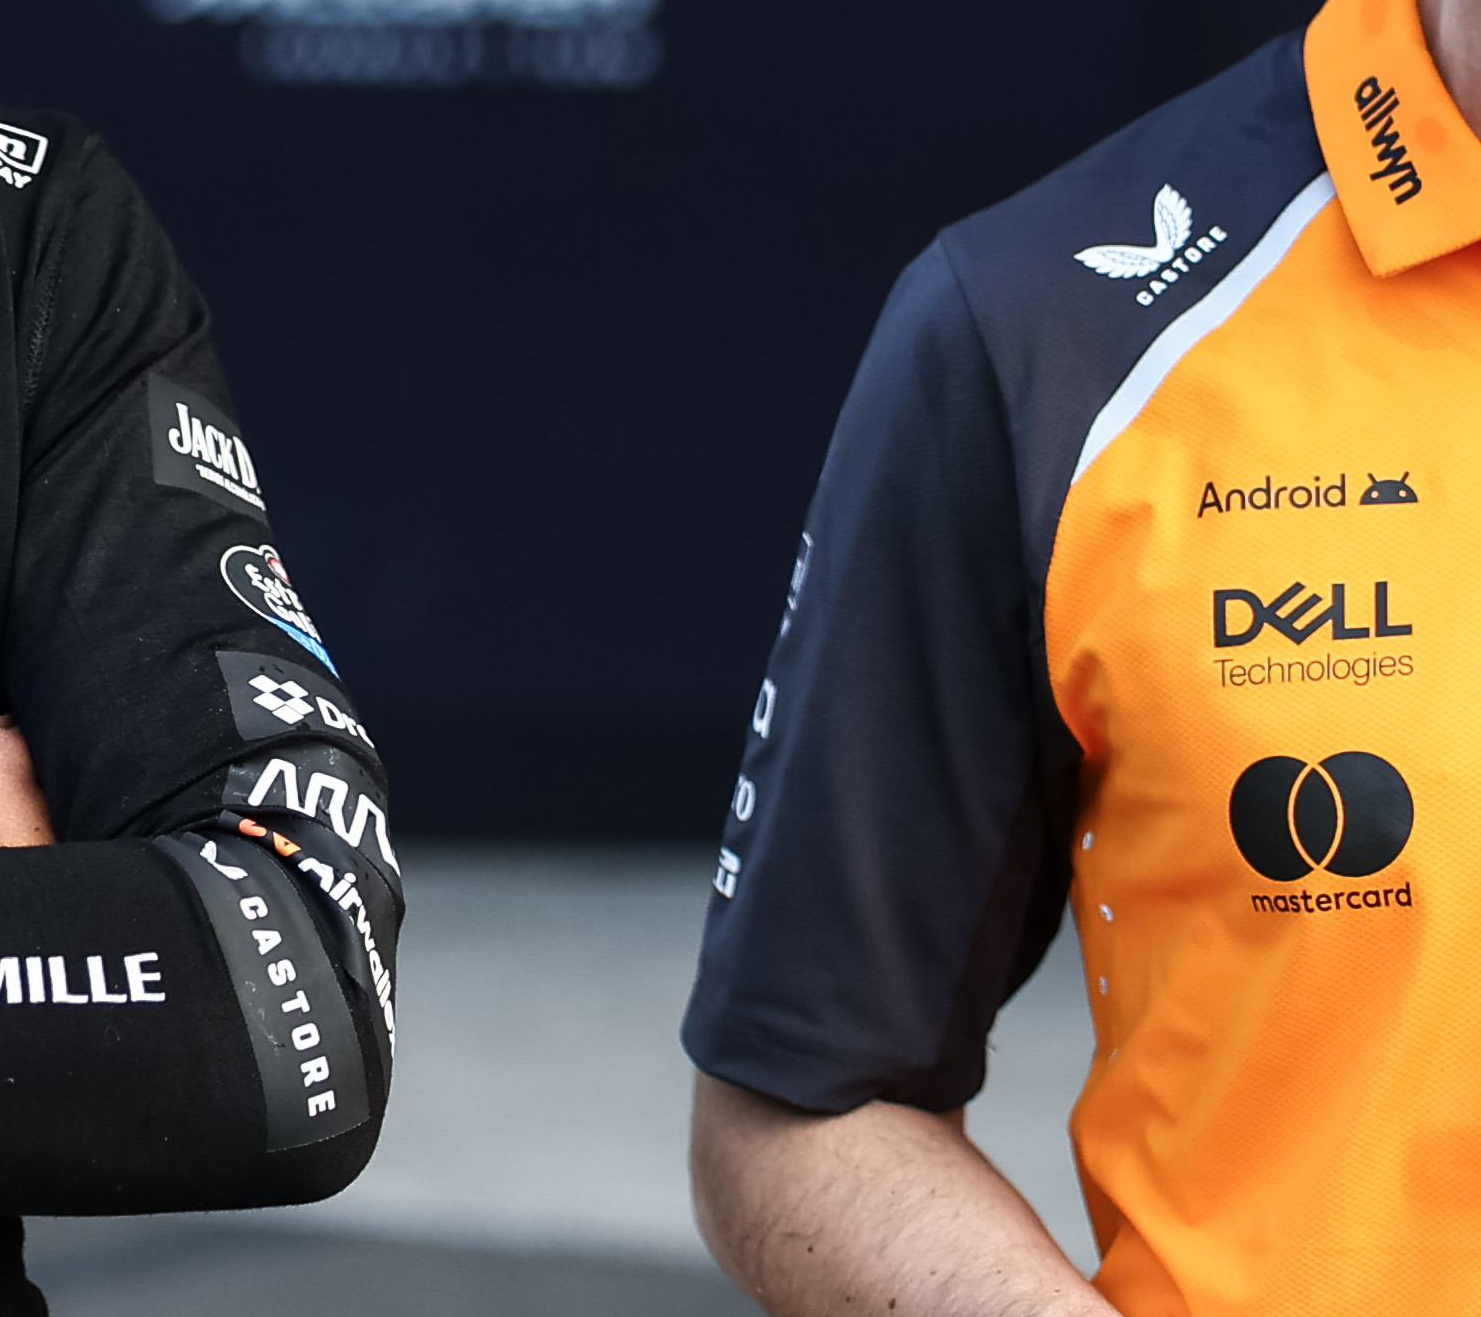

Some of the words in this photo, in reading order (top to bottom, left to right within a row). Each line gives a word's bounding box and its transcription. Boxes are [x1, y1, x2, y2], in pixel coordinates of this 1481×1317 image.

[1354, 76, 1422, 205] allwyn
[1136, 225, 1228, 306] CASTORE
[168, 402, 238, 480] JACK
[1197, 474, 1346, 519] Android
[1214, 581, 1413, 647] DELL
[1214, 652, 1414, 687] Technologies
[1251, 882, 1413, 914] mastercard
[240, 895, 336, 1117] CASTORE
